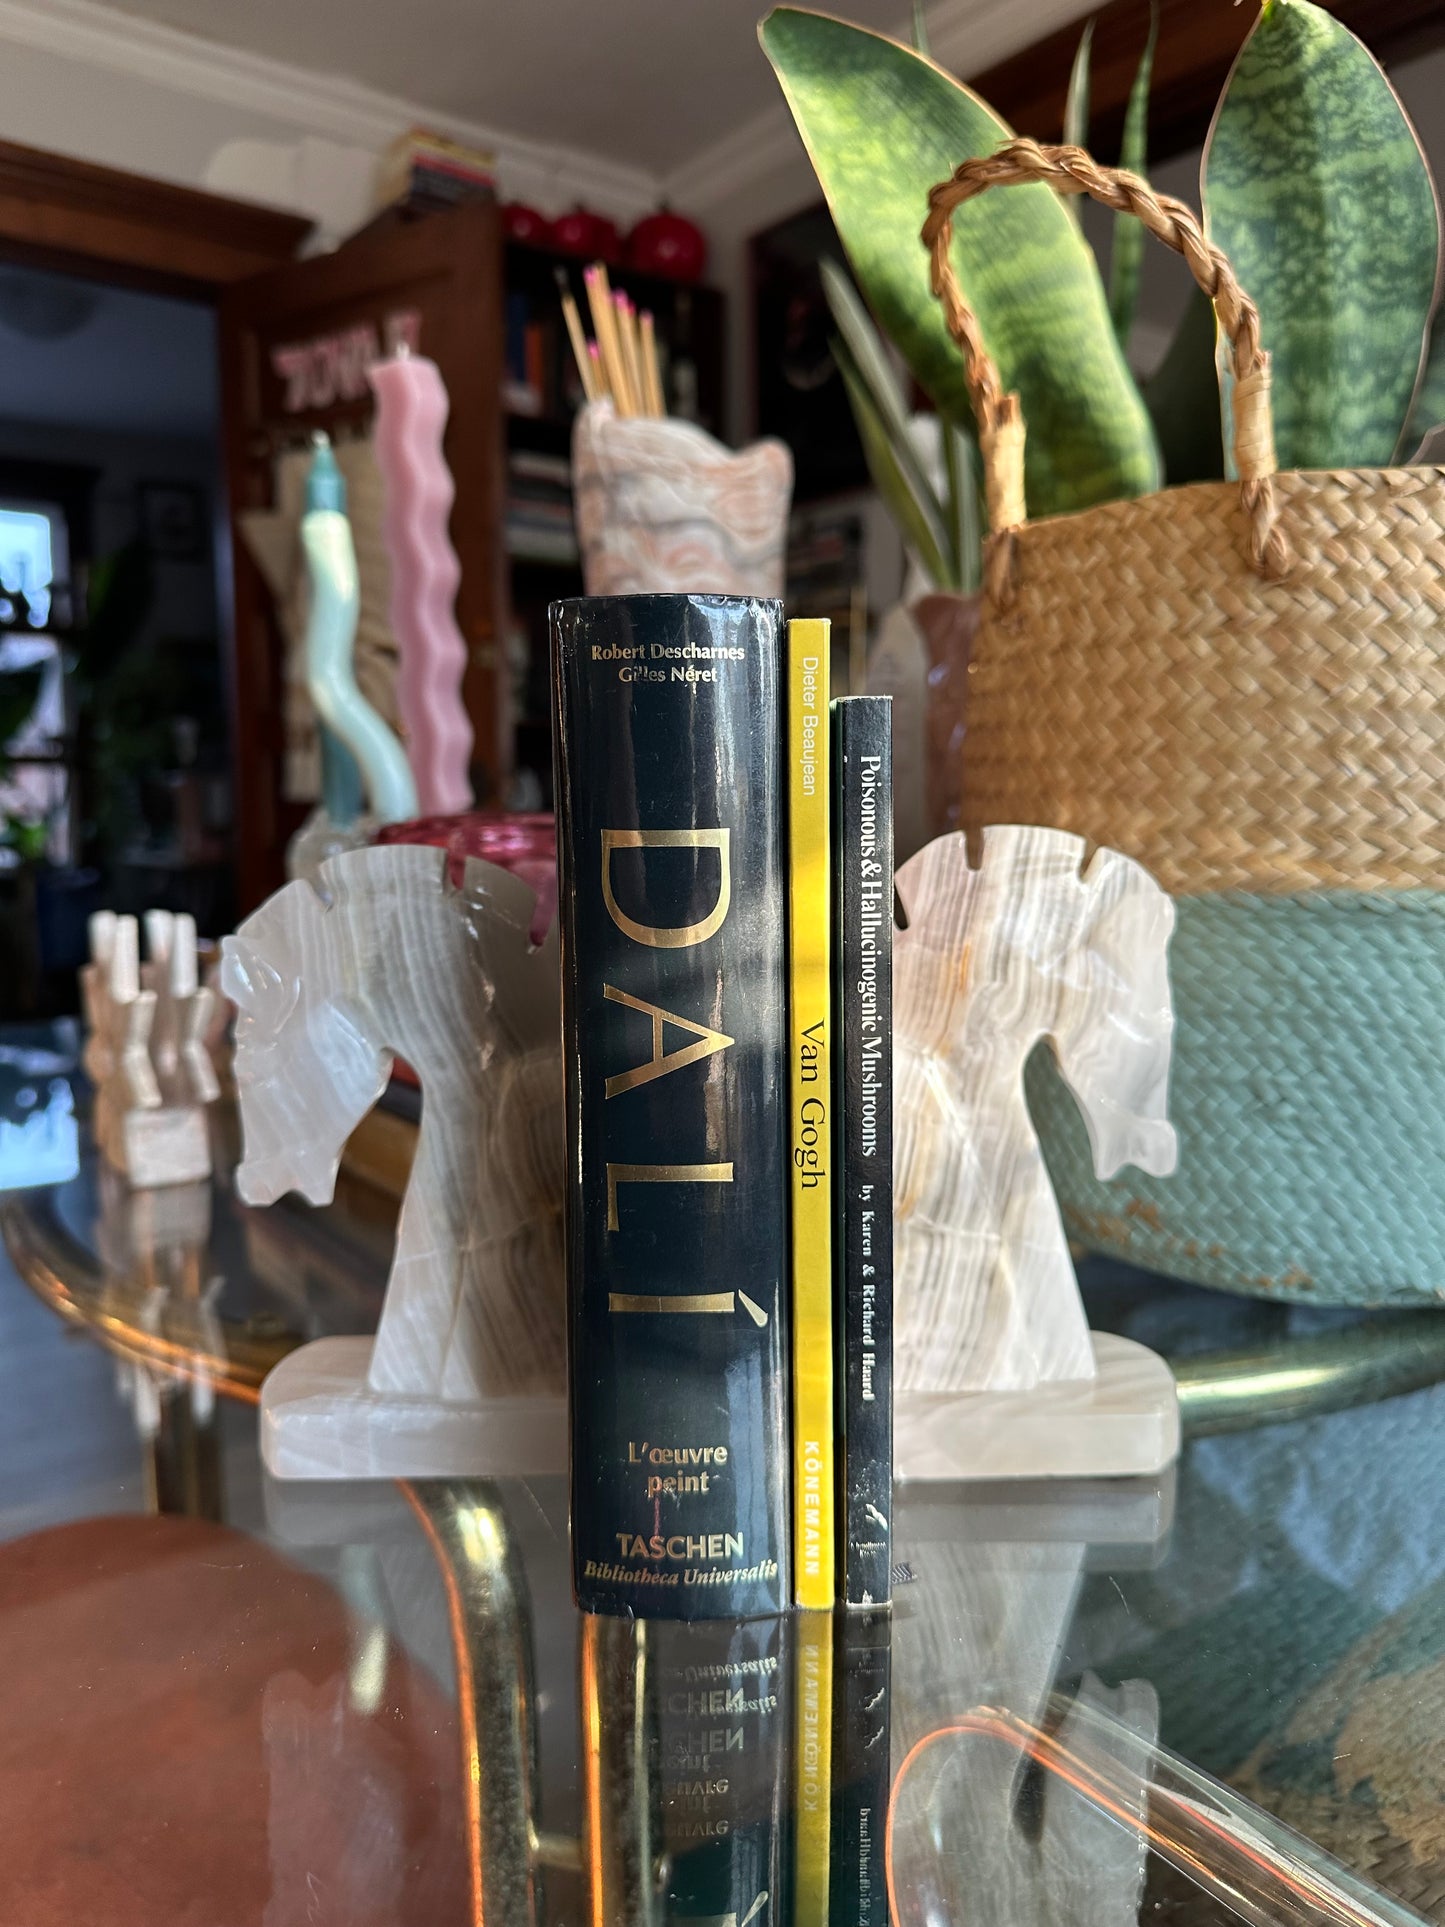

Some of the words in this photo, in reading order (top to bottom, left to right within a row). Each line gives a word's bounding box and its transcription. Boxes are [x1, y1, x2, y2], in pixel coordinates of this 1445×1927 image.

[591, 643, 646, 660] Robert
[650, 642, 745, 660] Descharnes
[670, 664, 718, 682] Néret
[803, 657, 819, 709] Dieter
[799, 715, 819, 796] Beaujean
[860, 755, 882, 857] Poisonous
[860, 859, 882, 878] &
[857, 880, 883, 1031] Hallucinogenic
[800, 1019, 825, 1085] Van
[601, 828, 769, 1327] DALÍ
[861, 1036, 883, 1157] Mushrooms
[794, 1097, 826, 1191] Gogh
[858, 1185, 875, 1202] by
[862, 1210, 875, 1257] Karen
[862, 1264, 875, 1277] &
[862, 1284, 876, 1346] Richard
[862, 1352, 876, 1401] Haard
[647, 1470, 710, 1499] peint
[803, 1441, 821, 1575] KÖNEMANN
[616, 1531, 744, 1559] TASCHEN
[584, 1559, 679, 1585] Bibliotheca
[682, 1558, 778, 1585] Universalis
